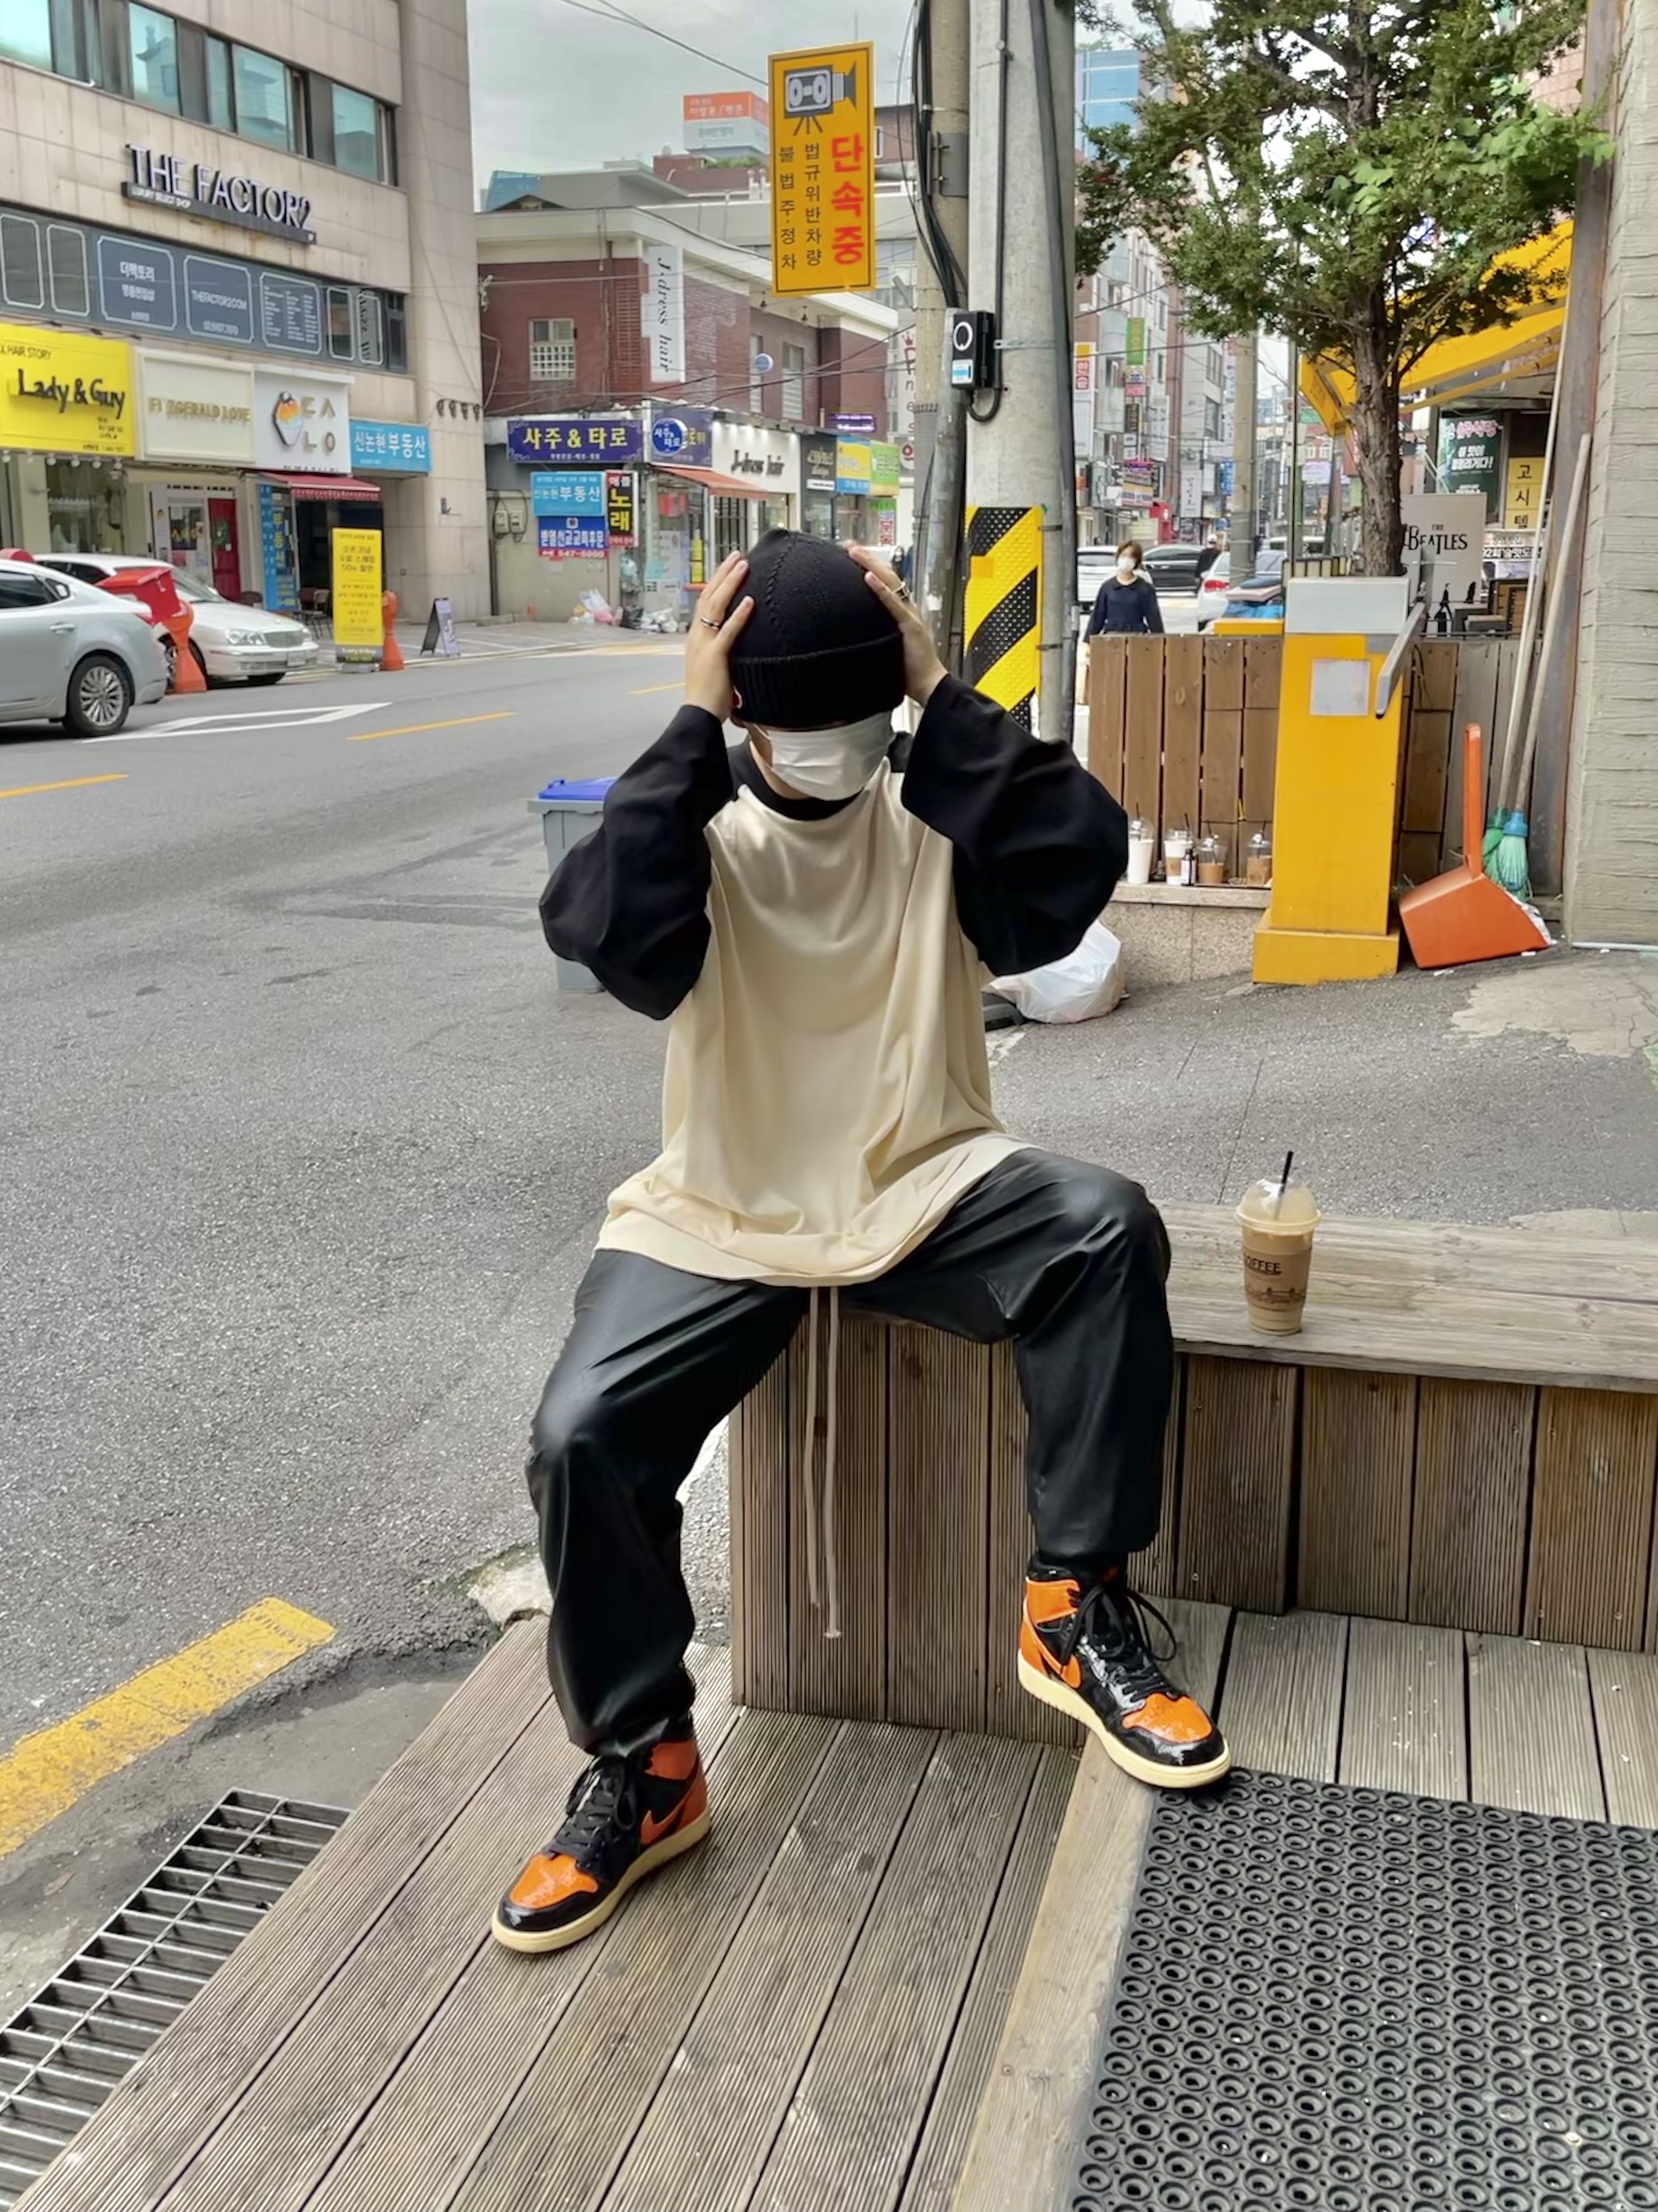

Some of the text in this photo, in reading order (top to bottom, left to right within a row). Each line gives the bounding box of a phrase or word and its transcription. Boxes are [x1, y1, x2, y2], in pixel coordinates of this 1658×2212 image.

[125, 144, 314, 231] THE FACTOR2
[831, 133, 864, 265] 단속중
[119, 261, 156, 282] 더팩토리
[660, 334, 673, 372] hair
[18, 369, 125, 420] Lady & Guy
[524, 427, 628, 450] 사주 & 타로
[664, 437, 681, 448] 타로
[608, 488, 632, 532] 노래
[1514, 464, 1533, 529] 고시텔
[1408, 525, 1468, 555] BEATLES
